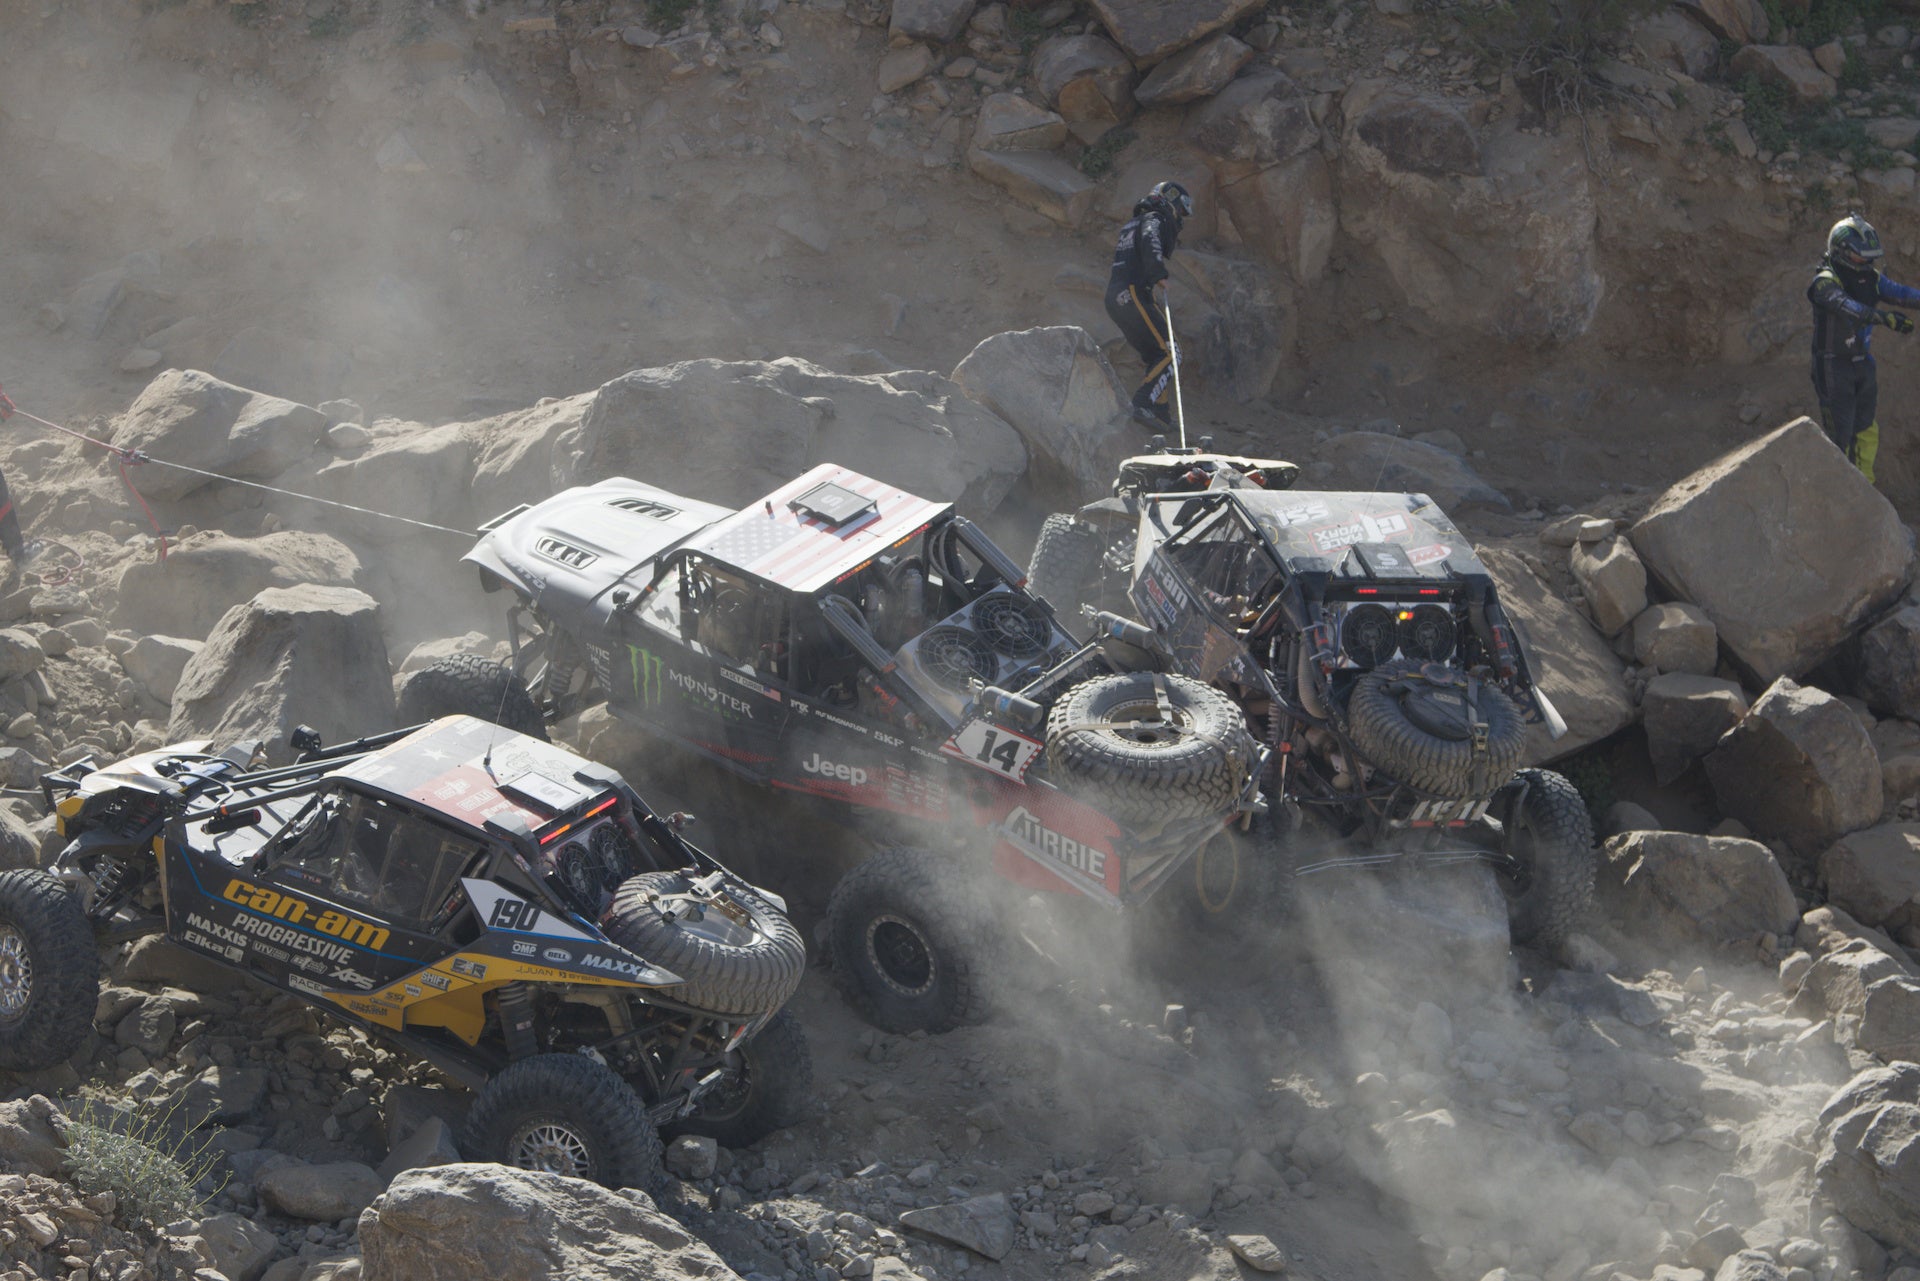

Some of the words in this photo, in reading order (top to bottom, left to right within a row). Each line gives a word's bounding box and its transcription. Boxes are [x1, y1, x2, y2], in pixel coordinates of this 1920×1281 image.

[669, 669, 754, 719] MONSTER
[873, 731, 904, 747] SKF
[977, 729, 1020, 773] 14
[802, 753, 868, 795] Jeep
[223, 878, 391, 950] can-am
[489, 898, 541, 931] 190
[184, 930, 226, 954] Elka
[186, 912, 249, 948] MAXXIS
[232, 912, 355, 965] PROGRESSIVE
[512, 943, 536, 955] OMP
[548, 952, 567, 960] BELL
[328, 965, 377, 991] XPS
[421, 972, 449, 988] SHIFT
[580, 953, 658, 980] MAXXIS
